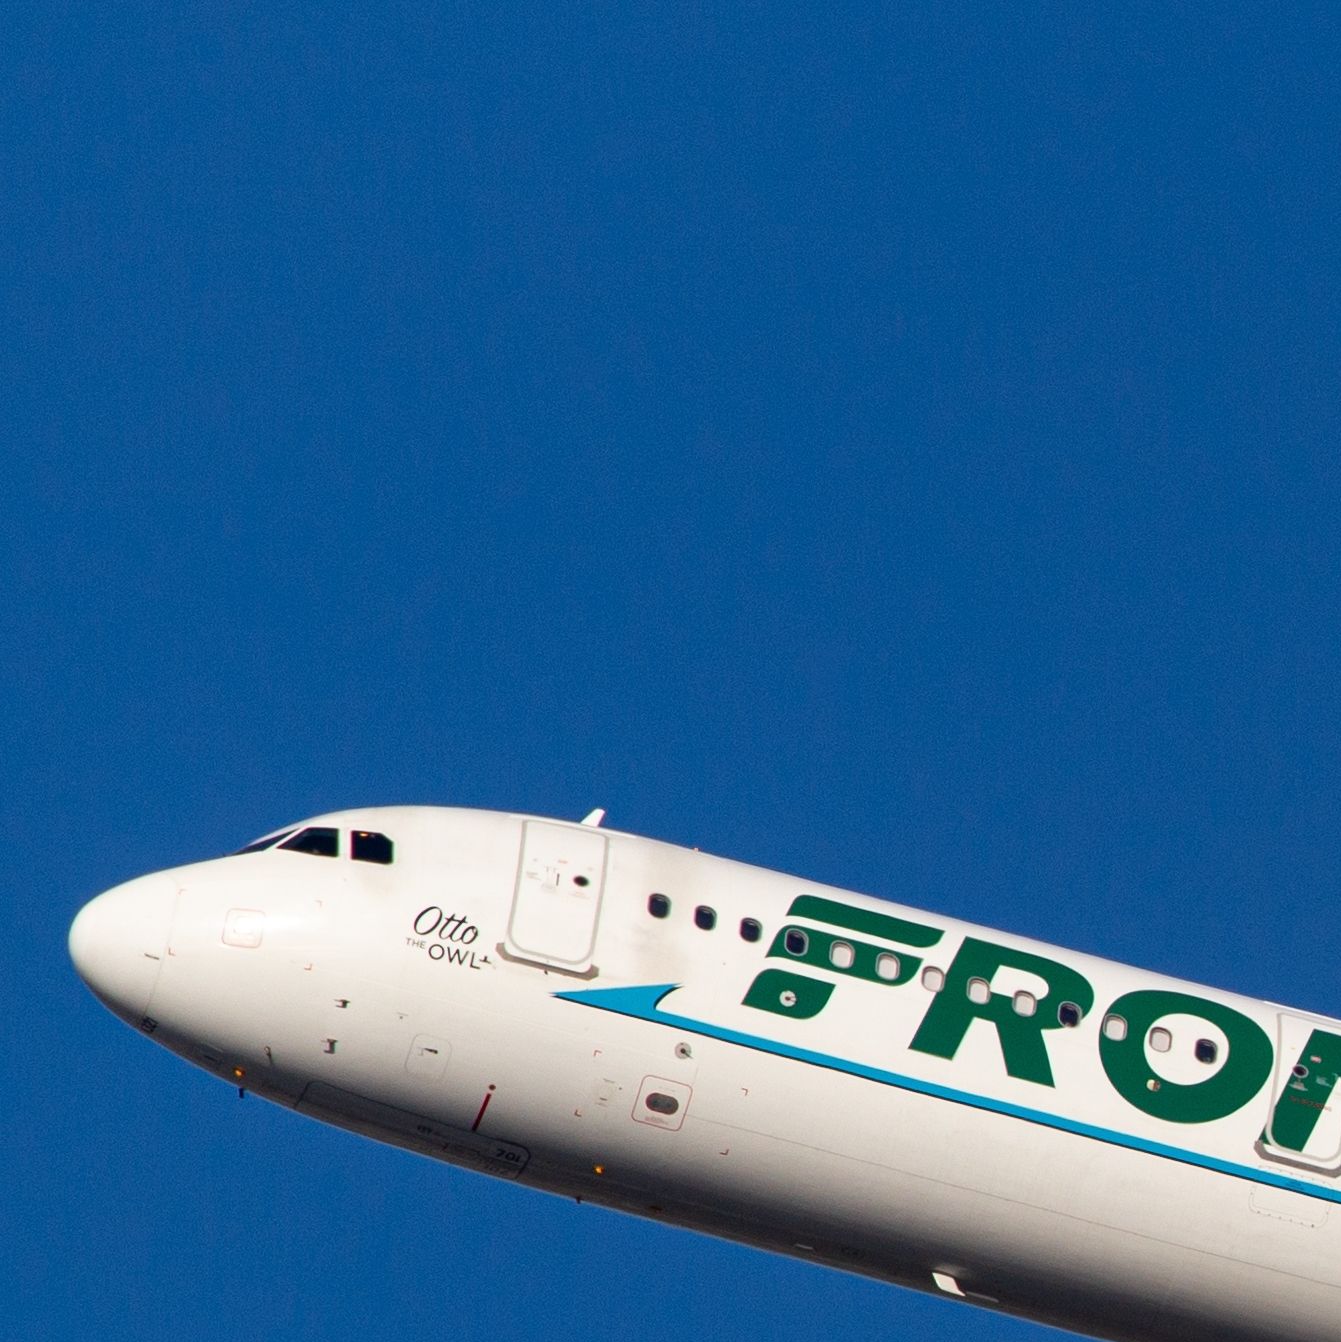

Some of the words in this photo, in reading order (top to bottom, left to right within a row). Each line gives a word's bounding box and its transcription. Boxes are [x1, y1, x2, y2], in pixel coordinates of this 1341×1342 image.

[412, 904, 480, 946] Otto
[405, 936, 427, 950] THE
[427, 943, 482, 971] OWL
